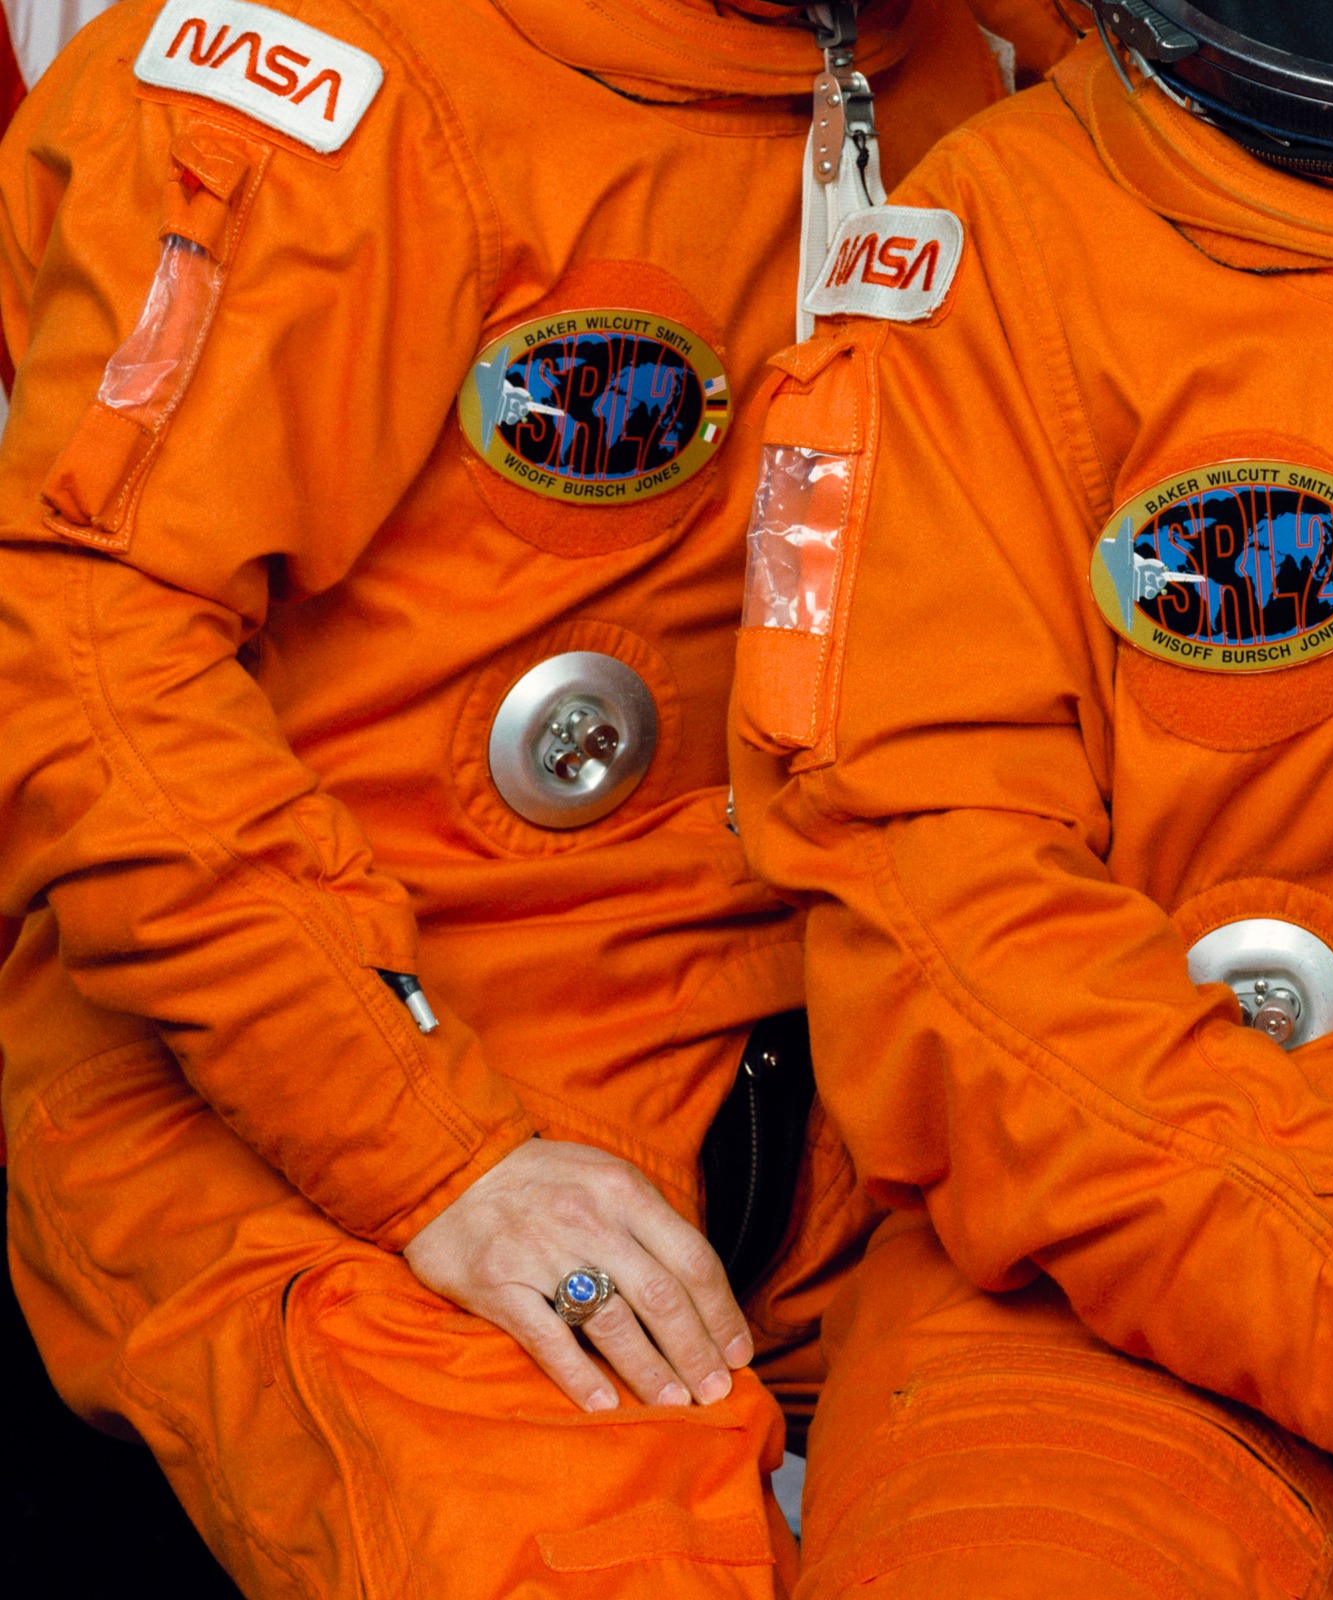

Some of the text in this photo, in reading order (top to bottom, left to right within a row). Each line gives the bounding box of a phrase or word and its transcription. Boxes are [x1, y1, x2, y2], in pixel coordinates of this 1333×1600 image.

[165, 17, 342, 123] NASA
[825, 232, 941, 292] NASA
[524, 317, 692, 355] BAKER WILCUTT SMITH
[503, 452, 681, 497] WISOFF BURSCH JONES
[1144, 478, 1200, 515] BAKER
[1206, 468, 1281, 486] WILCUTT
[1151, 628, 1213, 661] WISOFF
[1222, 645, 1292, 664] BURSCH
